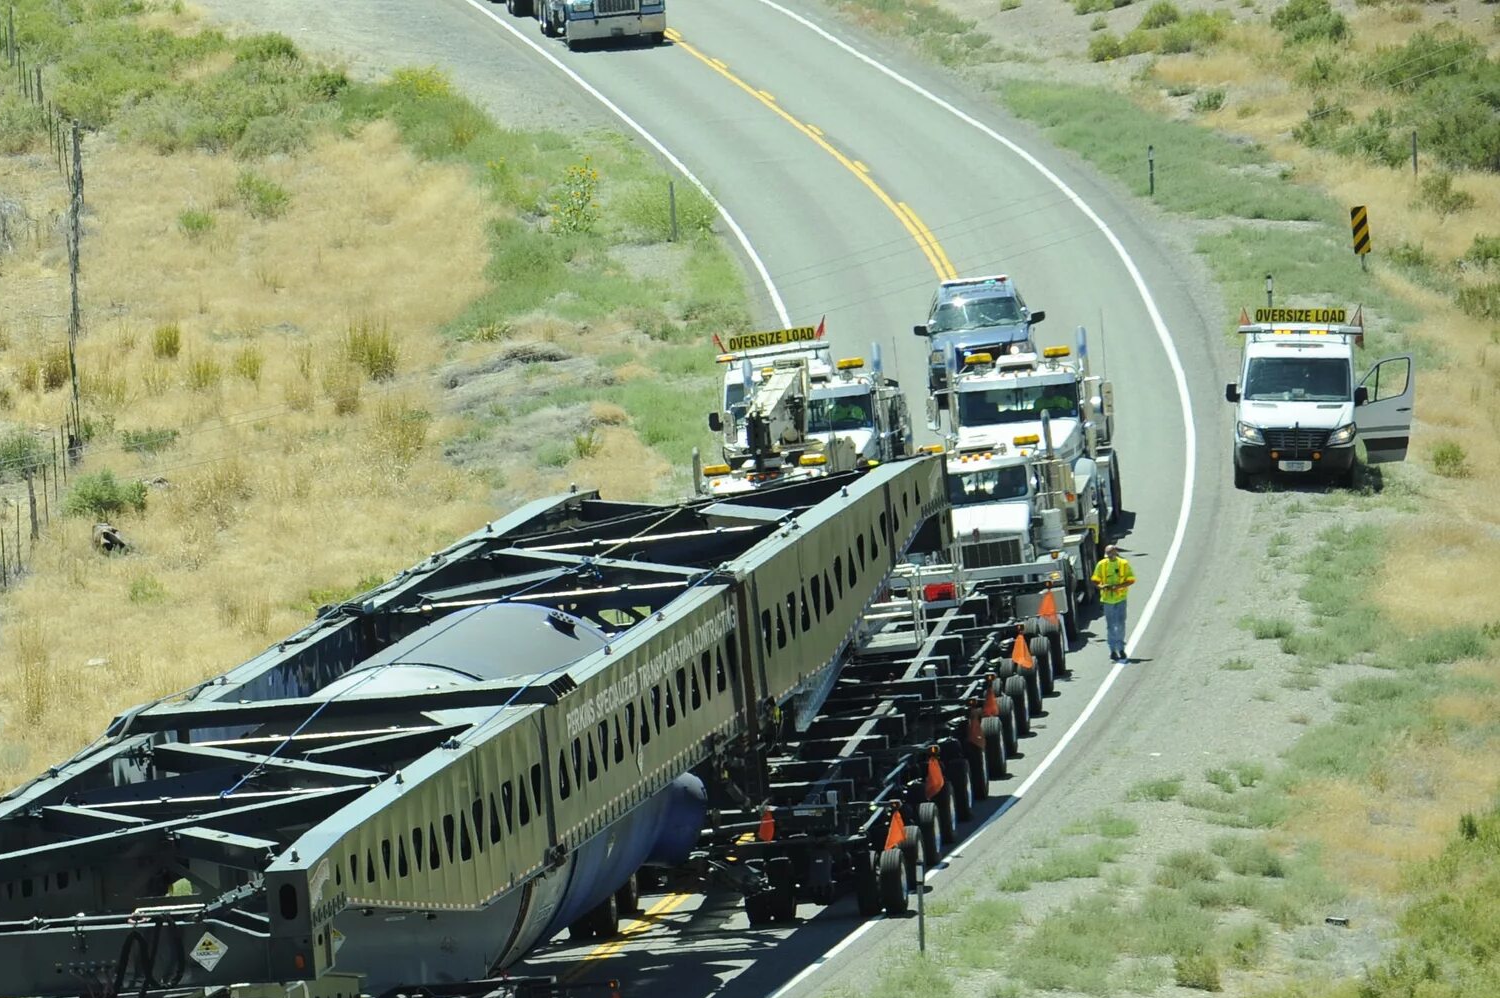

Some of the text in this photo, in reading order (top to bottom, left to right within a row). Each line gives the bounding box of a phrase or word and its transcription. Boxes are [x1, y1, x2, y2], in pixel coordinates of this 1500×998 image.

[1256, 308, 1346, 323] OVERSIZE LOAD
[729, 326, 815, 351] OVERSIZE LOAD
[596, 671, 638, 719] SPECIALIZED
[638, 633, 694, 691] TRANSPORTATION
[693, 603, 736, 654] CONTRACTING
